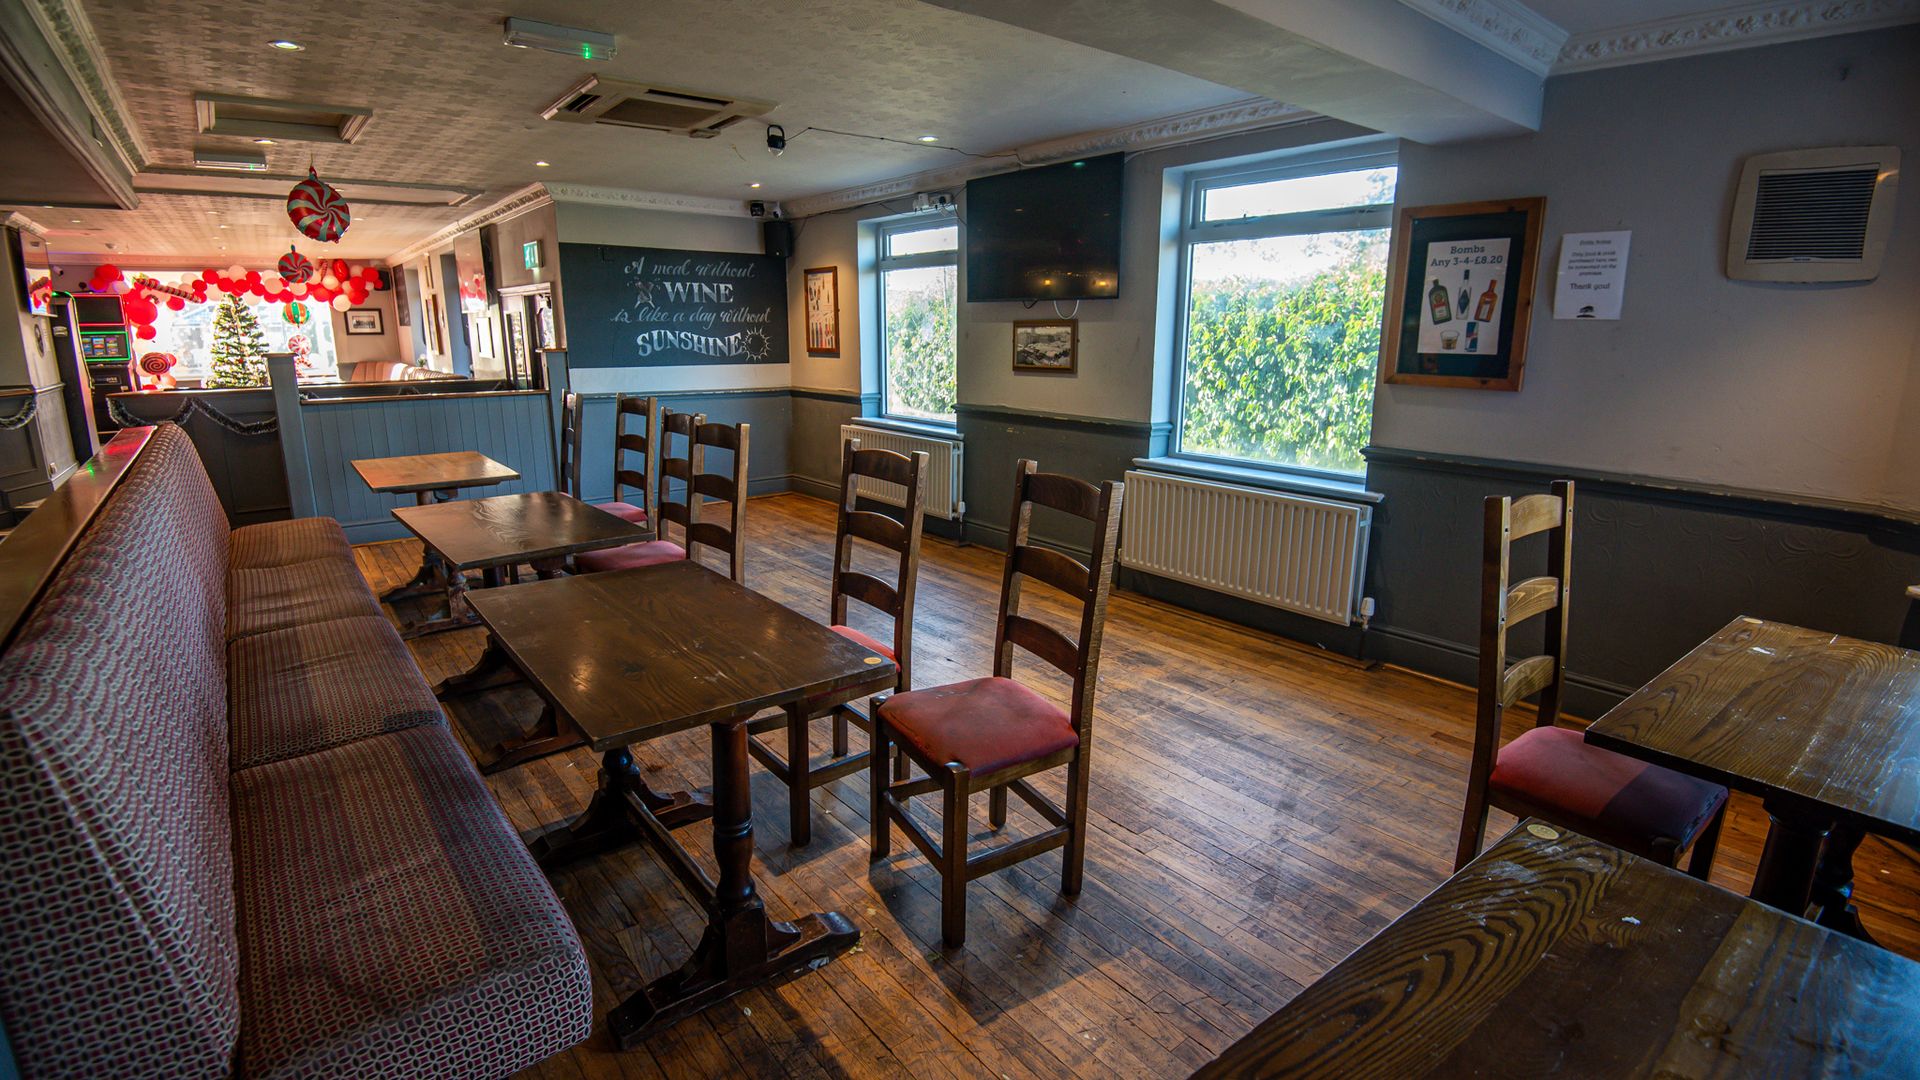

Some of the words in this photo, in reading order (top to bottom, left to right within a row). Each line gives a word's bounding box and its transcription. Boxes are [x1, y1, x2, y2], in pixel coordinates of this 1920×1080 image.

[1450, 245, 1486, 255] Bombs
[624, 256, 645, 275] A
[652, 259, 691, 275] meal
[695, 261, 755, 278] without
[1431, 257, 1451, 268] Any
[663, 282, 734, 303] WINE
[611, 307, 632, 324] is
[637, 305, 668, 323] like
[672, 310, 686, 323] a
[688, 305, 717, 330] day
[719, 306, 772, 324] without
[636, 329, 743, 357] SUNSHINE
